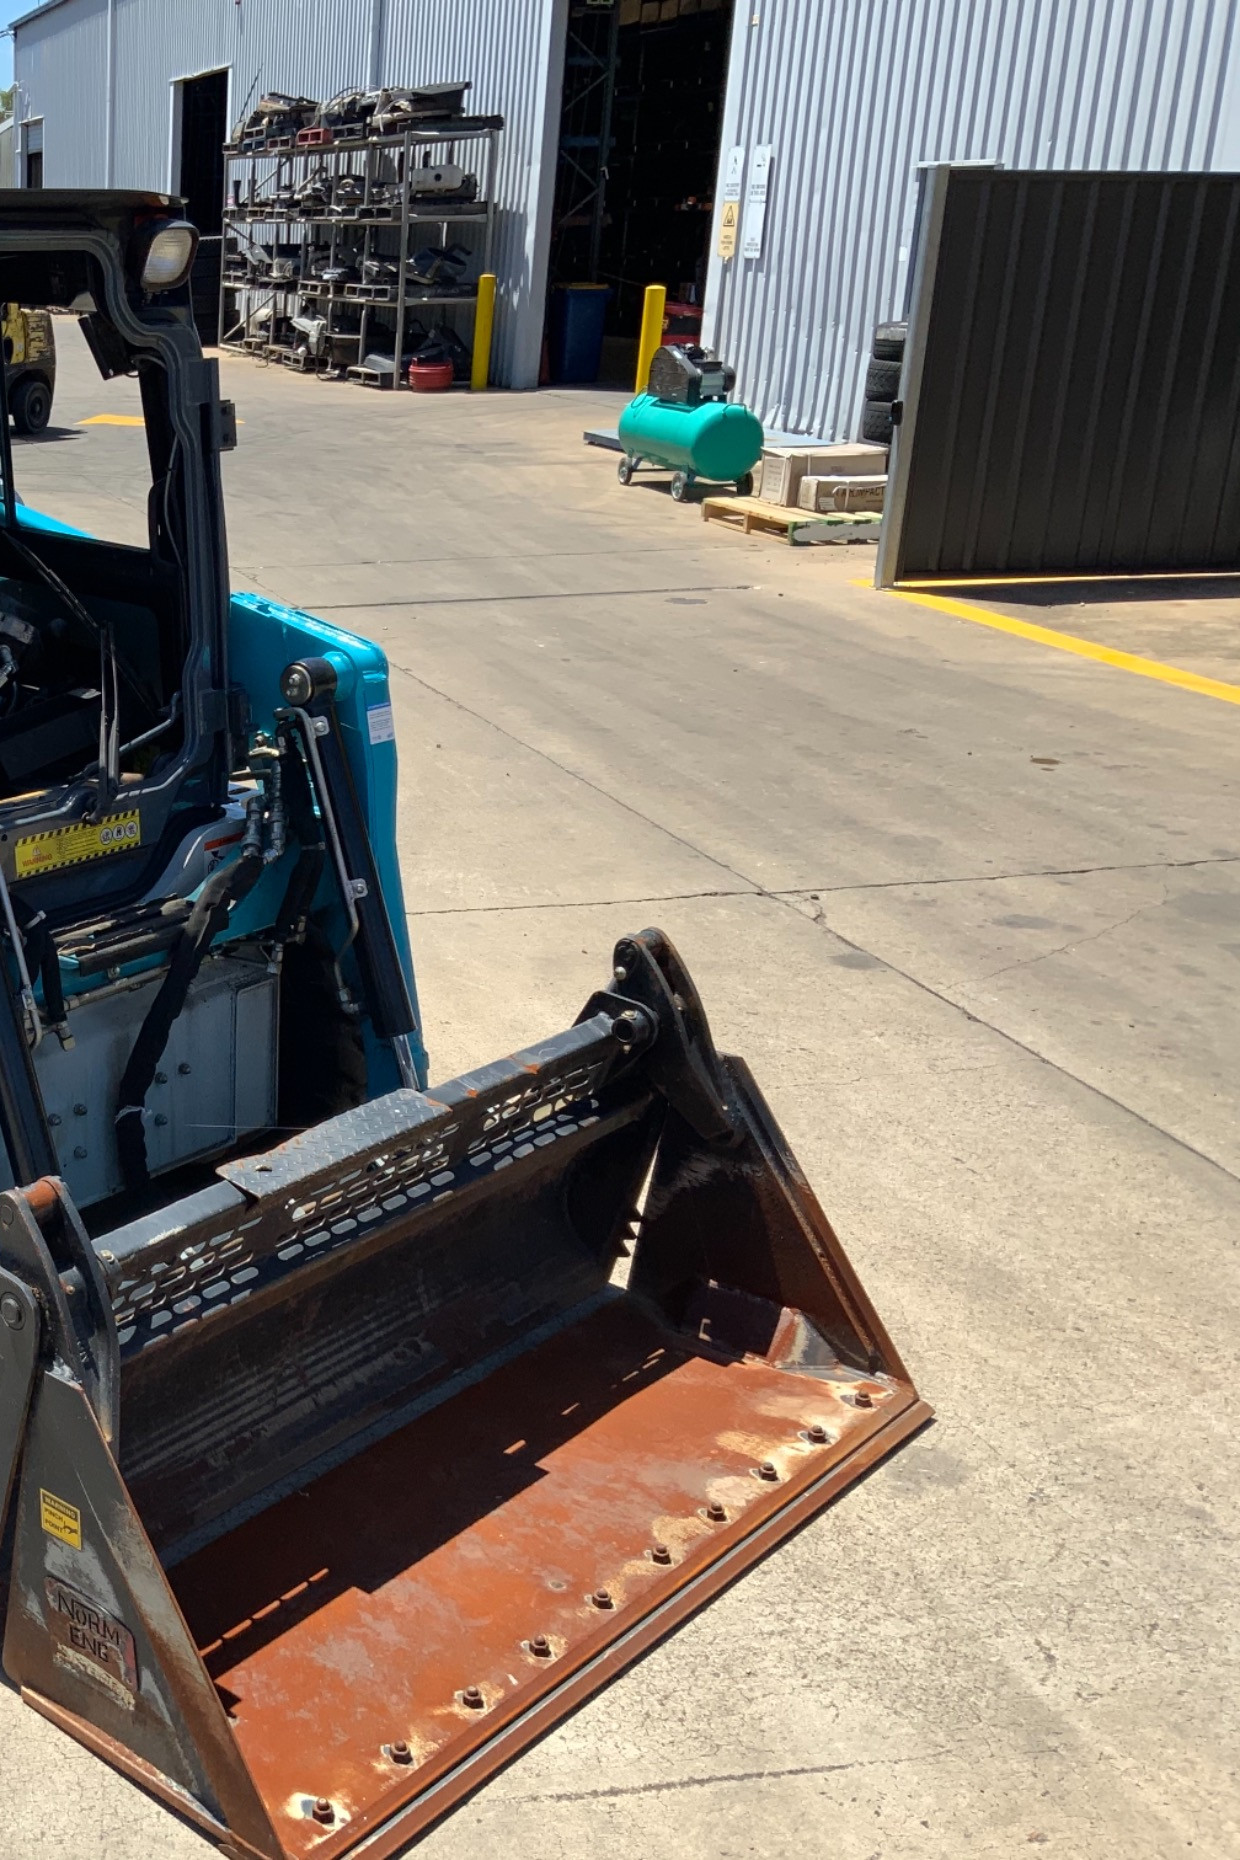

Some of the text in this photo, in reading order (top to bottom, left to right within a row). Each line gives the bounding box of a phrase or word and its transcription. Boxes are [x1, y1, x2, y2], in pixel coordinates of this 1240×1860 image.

[22, 853, 53, 867] WARNING
[44, 1496, 76, 1519] WARNING
[44, 1507, 64, 1522] PINCH
[44, 1519, 63, 1533] POINT
[57, 1590, 120, 1646] NORM
